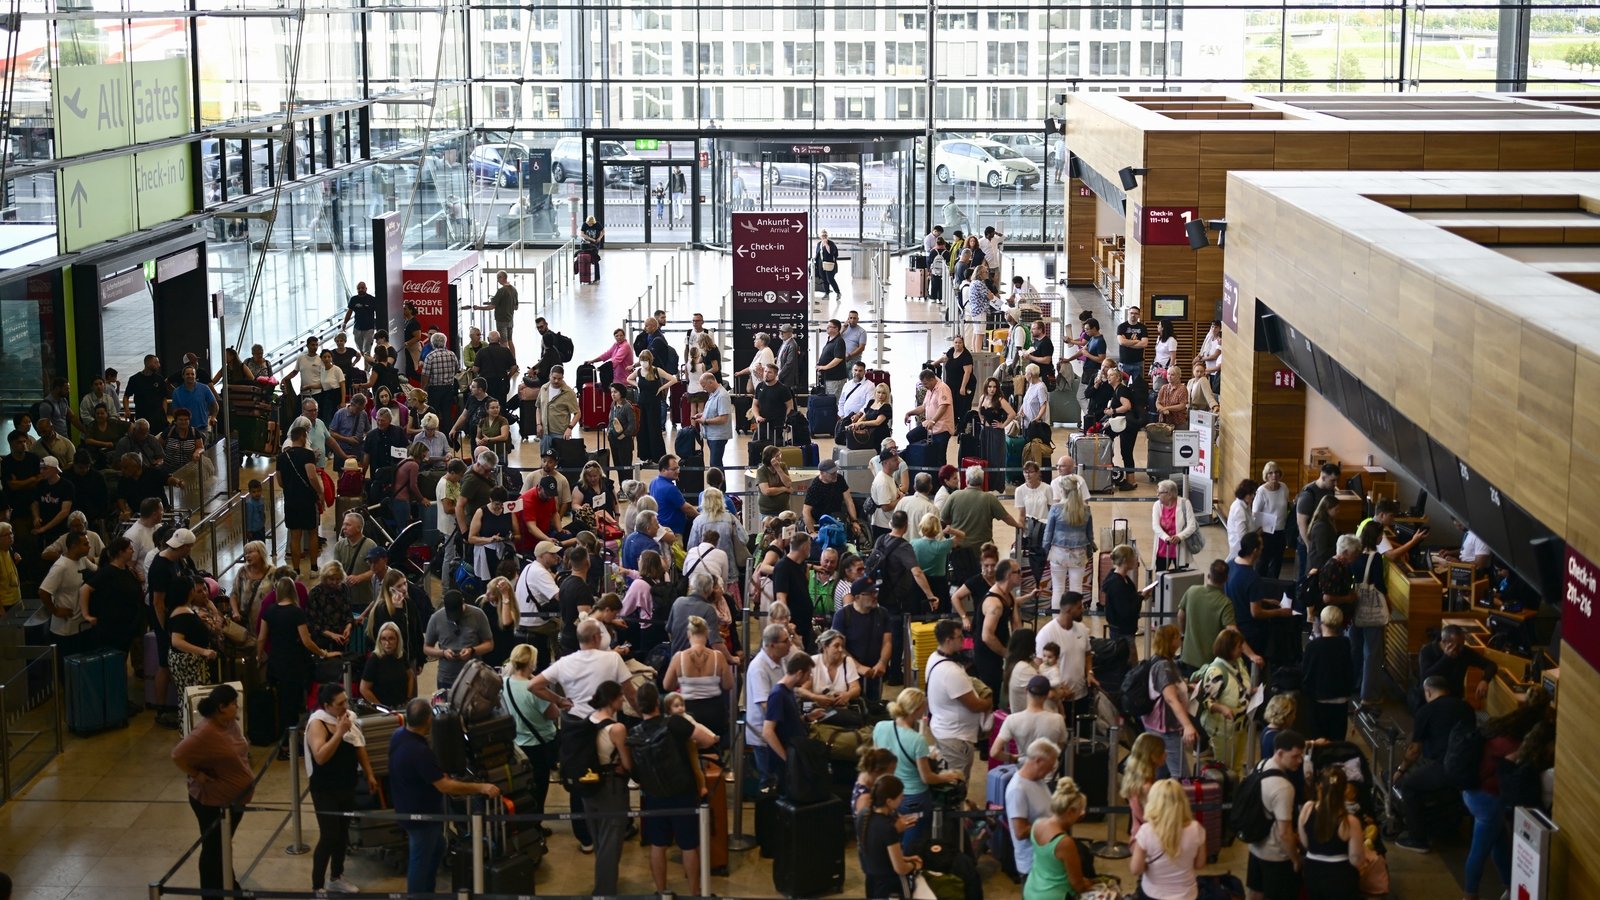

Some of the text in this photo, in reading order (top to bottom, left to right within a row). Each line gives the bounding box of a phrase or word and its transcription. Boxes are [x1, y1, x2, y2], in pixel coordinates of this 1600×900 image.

[98, 78, 180, 131] All Gates
[179, 158, 185, 182] 0
[757, 218, 790, 226] Ankunft
[1180, 211, 1192, 238] 1
[750, 251, 756, 259] 0
[756, 265, 790, 273] Check-in
[402, 279, 443, 294] Coca-Cola
[415, 306, 443, 316] RLIN
[1568, 556, 1597, 595] Check-in
